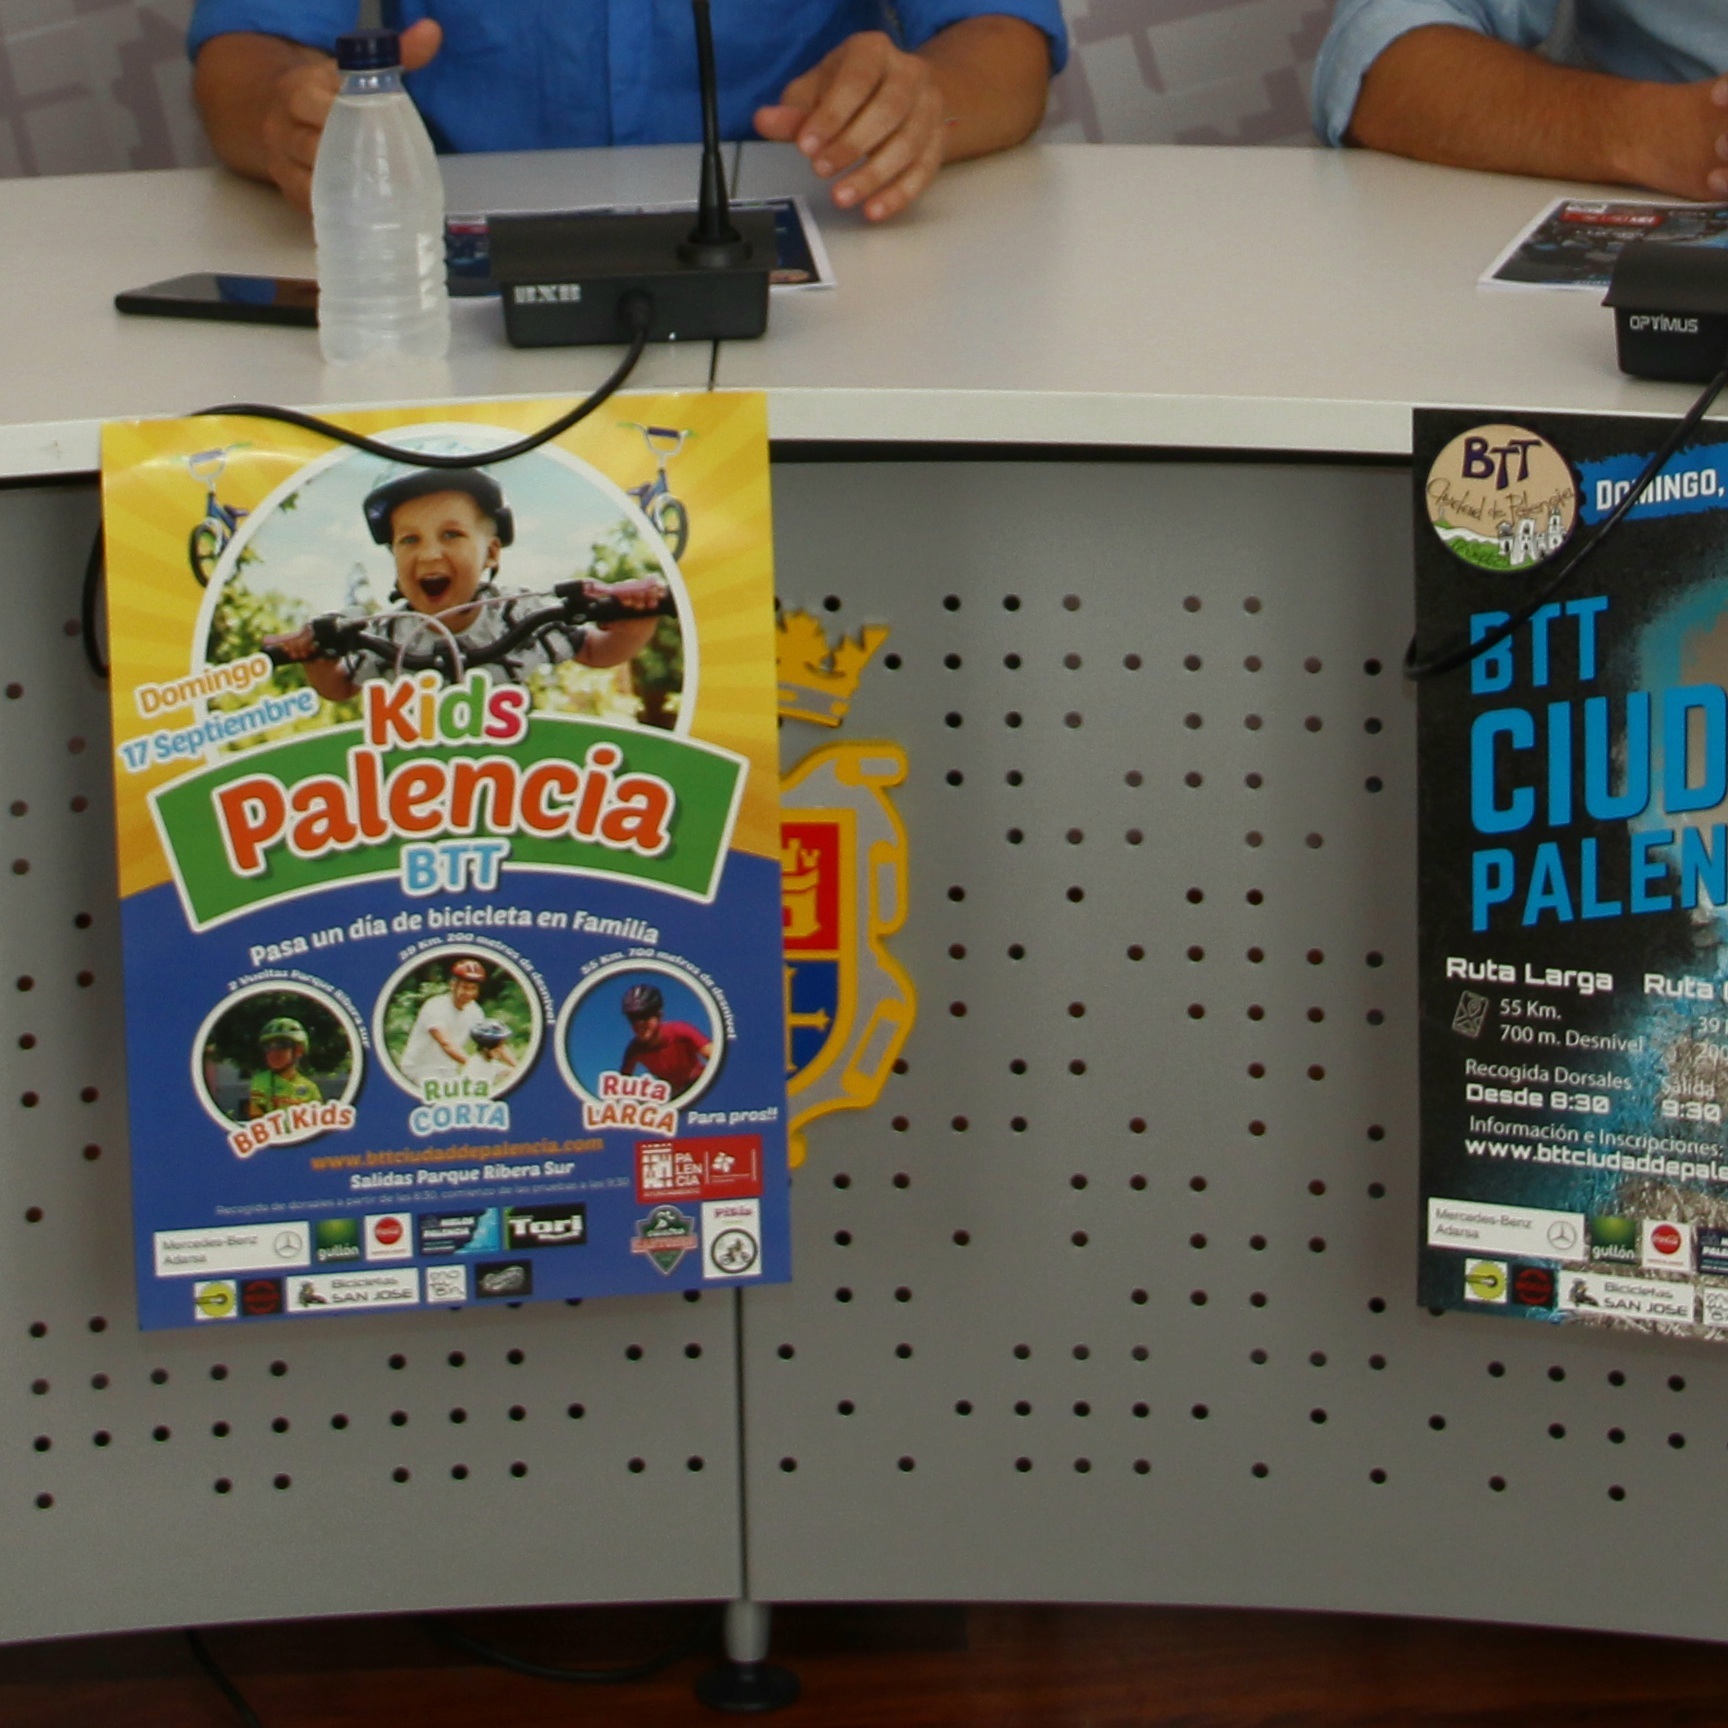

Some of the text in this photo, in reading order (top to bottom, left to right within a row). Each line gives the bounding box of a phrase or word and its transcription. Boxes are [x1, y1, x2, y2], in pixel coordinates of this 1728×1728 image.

[1629, 314, 1699, 332] OPTIMUS
[1462, 436, 1542, 490] BTT
[1471, 595, 1609, 694] BTT
[140, 655, 269, 713] Domingo
[370, 677, 524, 746] Kids
[123, 691, 315, 771] 17 Septiembre
[219, 751, 671, 870] Palencia
[406, 844, 504, 892] BTT
[250, 906, 658, 966] Pasa un día de bicicleta en Familia
[1446, 957, 1613, 994] Ruta Larga
[1643, 973, 1714, 1000] Ruta
[1500, 999, 1562, 1019] 55 Km.
[1499, 1025, 1643, 1052] 700 Desnivel
[426, 1077, 489, 1100] Ruta
[603, 1074, 667, 1100] Ruta
[1466, 1059, 1633, 1090] Recogida Dorsales
[1466, 1083, 1610, 1114] Desde 8:30
[1661, 1100, 1721, 1121] 9:30
[292, 1105, 352, 1129] Kids
[414, 1104, 508, 1132] CORTA
[587, 1105, 675, 1133] LARGA
[688, 1111, 727, 1125] Para
[1470, 1115, 1723, 1157] Información Inscripciones:
[350, 1161, 575, 1189] Salidas Parque Ribera Sur
[1603, 1297, 1640, 1311] SAN
